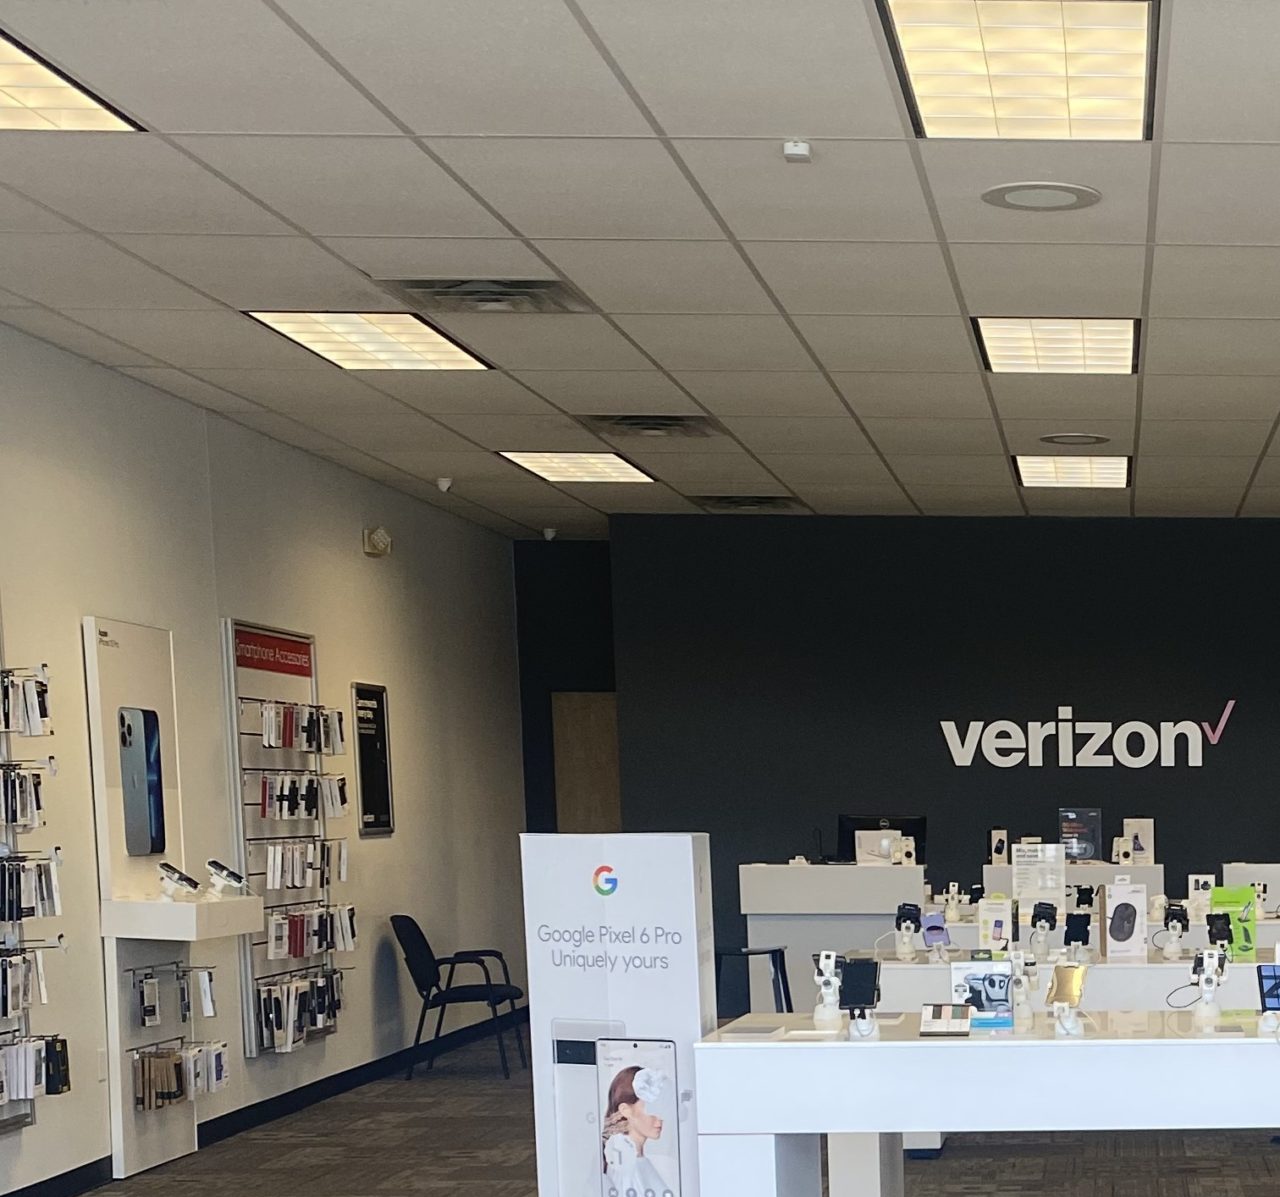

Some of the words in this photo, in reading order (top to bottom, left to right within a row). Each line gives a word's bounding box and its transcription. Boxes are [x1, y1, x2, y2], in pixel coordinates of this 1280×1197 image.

[235, 638, 275, 662] Smartphone
[275, 647, 310, 667] Accessories
[940, 706, 1203, 769] verizon
[592, 865, 618, 896] G
[537, 924, 596, 948] Google
[599, 925, 635, 944] Pixel
[639, 928, 650, 944] 6
[654, 926, 682, 945] Pro
[551, 949, 617, 973] Uniquely
[622, 955, 669, 973] yours
